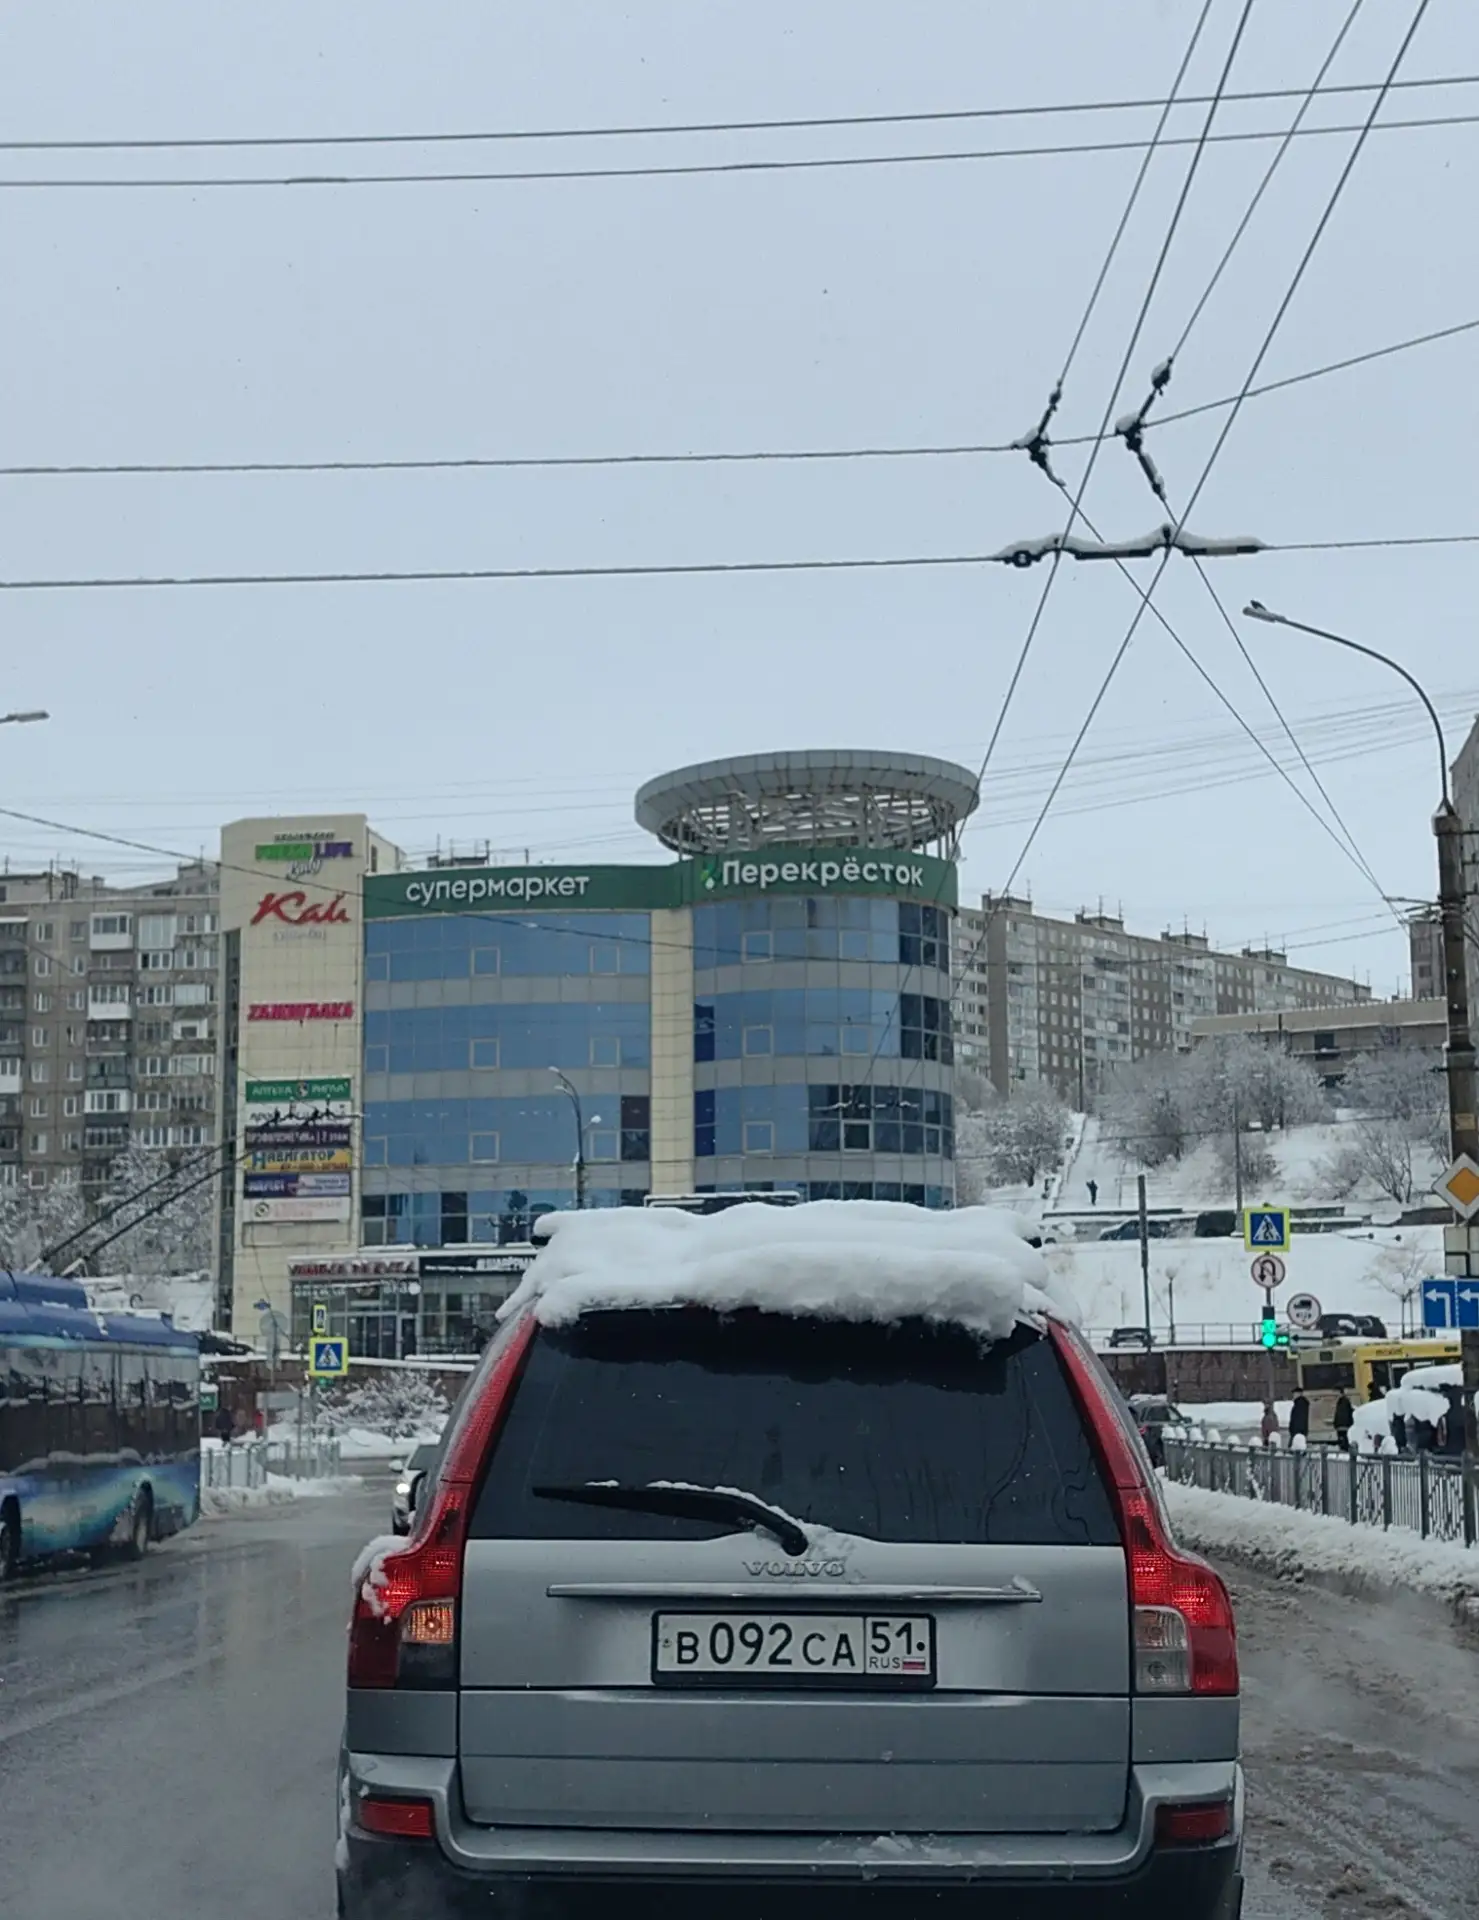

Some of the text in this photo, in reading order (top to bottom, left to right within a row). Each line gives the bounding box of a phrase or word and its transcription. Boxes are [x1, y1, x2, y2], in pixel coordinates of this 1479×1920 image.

[723, 855, 924, 889] Перекрёсток
[405, 873, 590, 905] супермаркет
[743, 1560, 845, 1577] VOLVO
[870, 1621, 914, 1655] 51
[869, 1657, 901, 1669] RUS
